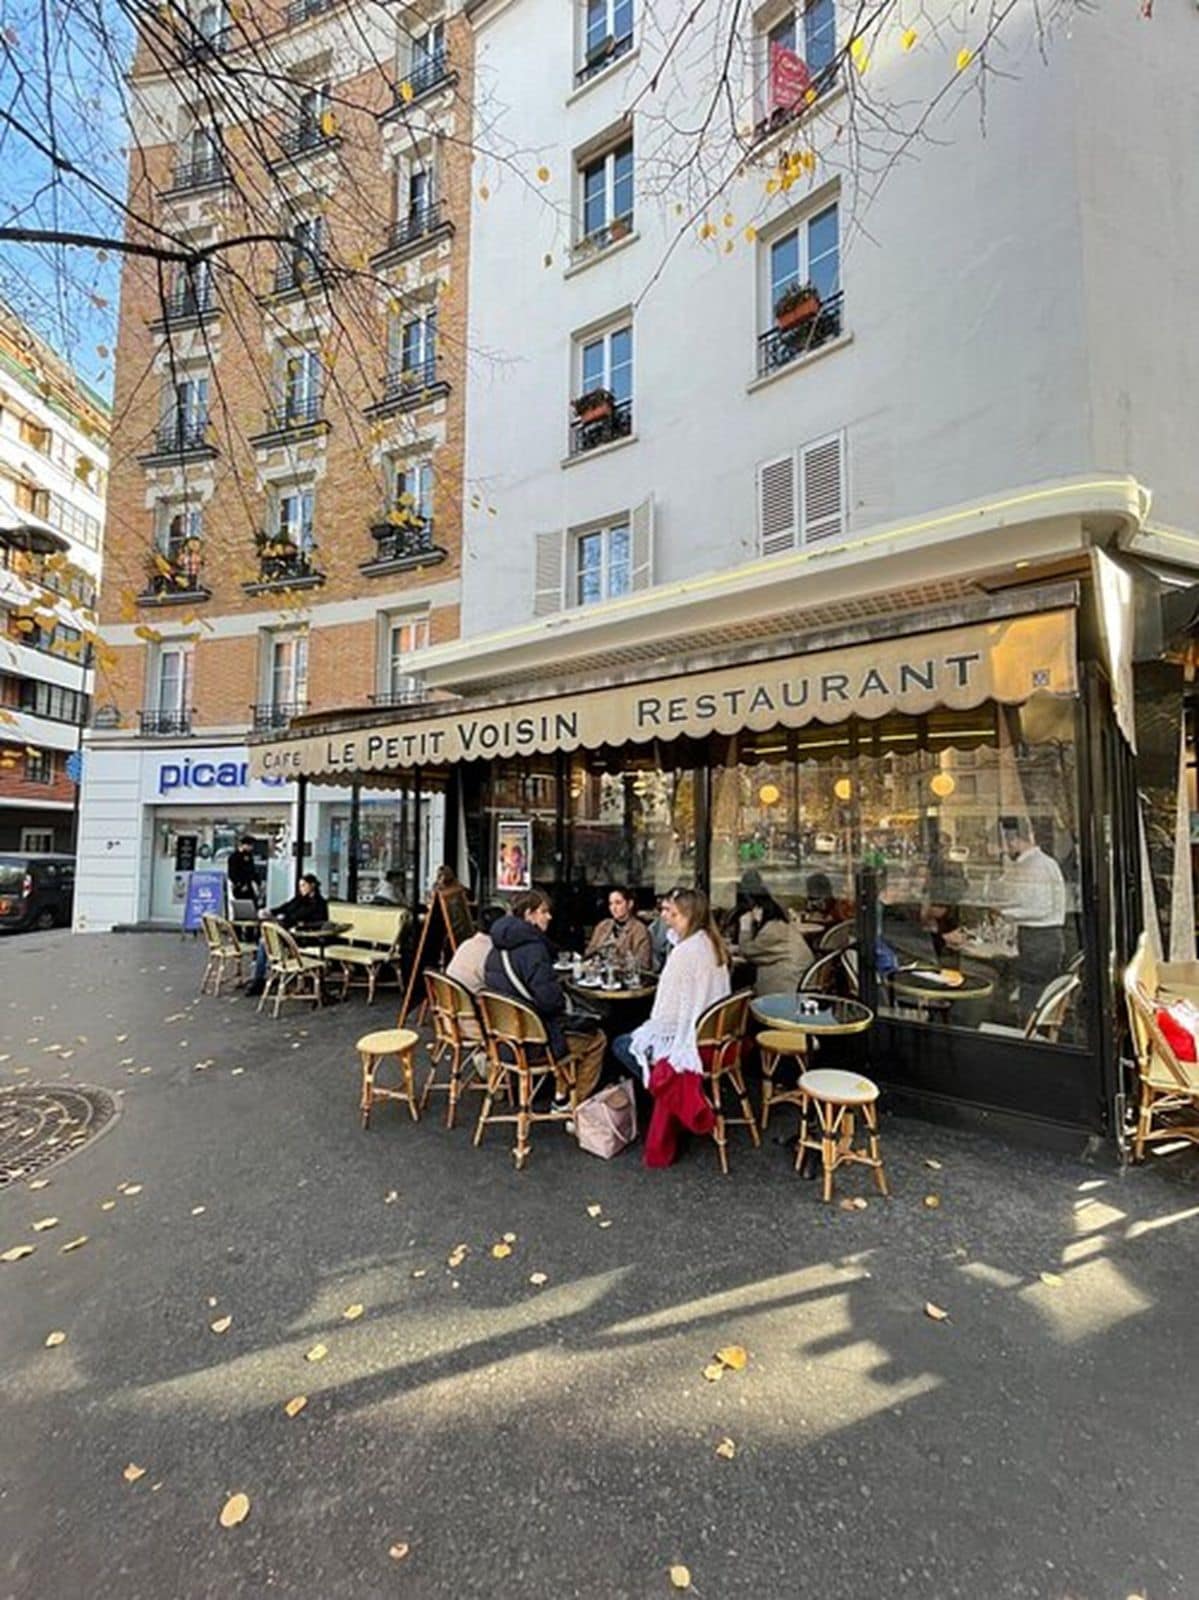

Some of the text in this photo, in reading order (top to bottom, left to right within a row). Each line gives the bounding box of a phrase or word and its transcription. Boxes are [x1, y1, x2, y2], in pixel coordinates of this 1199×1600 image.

[327, 743, 355, 764] LE
[368, 731, 445, 760] PETIT
[457, 712, 577, 750] VOISIN
[638, 654, 979, 727] RESTAURANT
[158, 757, 288, 794] picar
